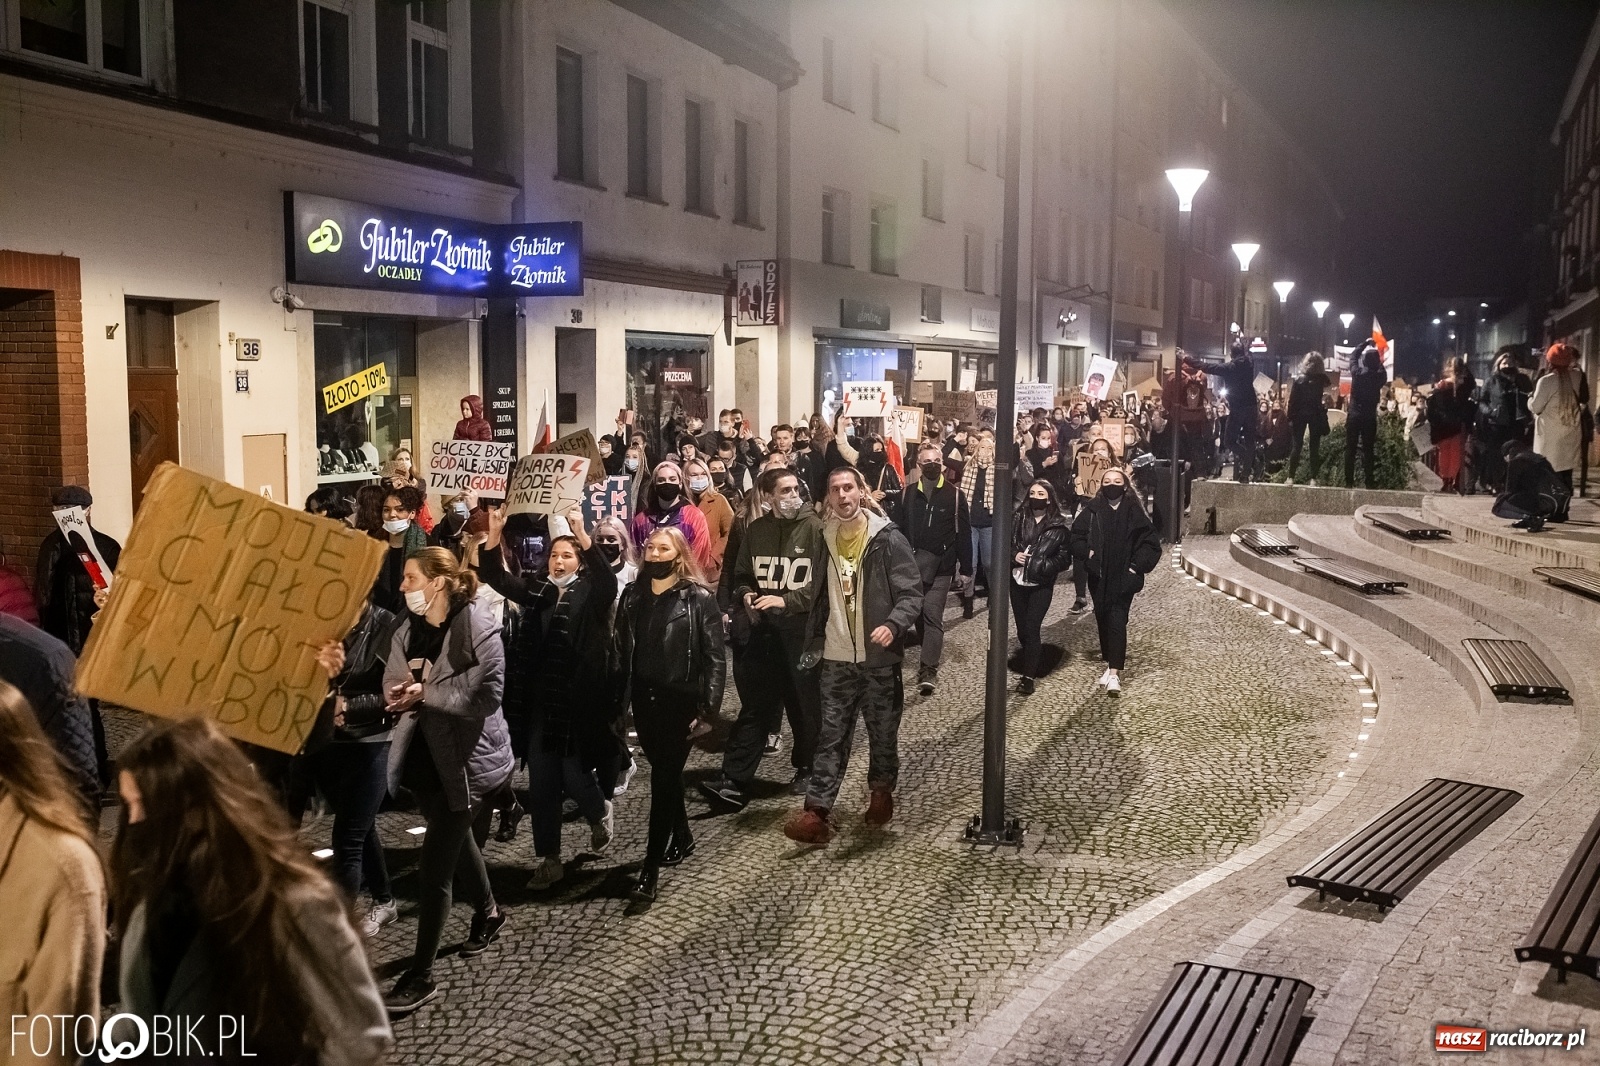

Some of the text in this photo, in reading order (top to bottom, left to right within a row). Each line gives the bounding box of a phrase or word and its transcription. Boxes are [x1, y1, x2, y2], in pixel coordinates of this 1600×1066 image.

[360, 218, 492, 276] Jubiler Złotnik
[510, 236, 565, 263] Jubiler
[378, 264, 423, 281] OCZADŁY
[510, 264, 566, 288] Złotnik
[243, 342, 259, 356] 36
[238, 377, 247, 388] 36
[664, 371, 692, 383] PRZECENA
[325, 367, 386, 409] ZŁOTO -10%
[492, 399, 516, 409] SPRZEDAŻ
[497, 428, 515, 437] SREBRA
[432, 441, 482, 457] CHCESZ
[430, 456, 457, 470] GOD
[456, 457, 478, 474] ALE
[1080, 456, 1091, 467] TO
[430, 472, 507, 492] TYLKO GODEK
[513, 474, 567, 491] GODEK
[513, 490, 552, 505] MNIE
[185, 486, 353, 573] MOJE
[158, 534, 350, 621] CIAŁO
[178, 603, 322, 689] MÓJ
[125, 648, 316, 742] WYBÓR
